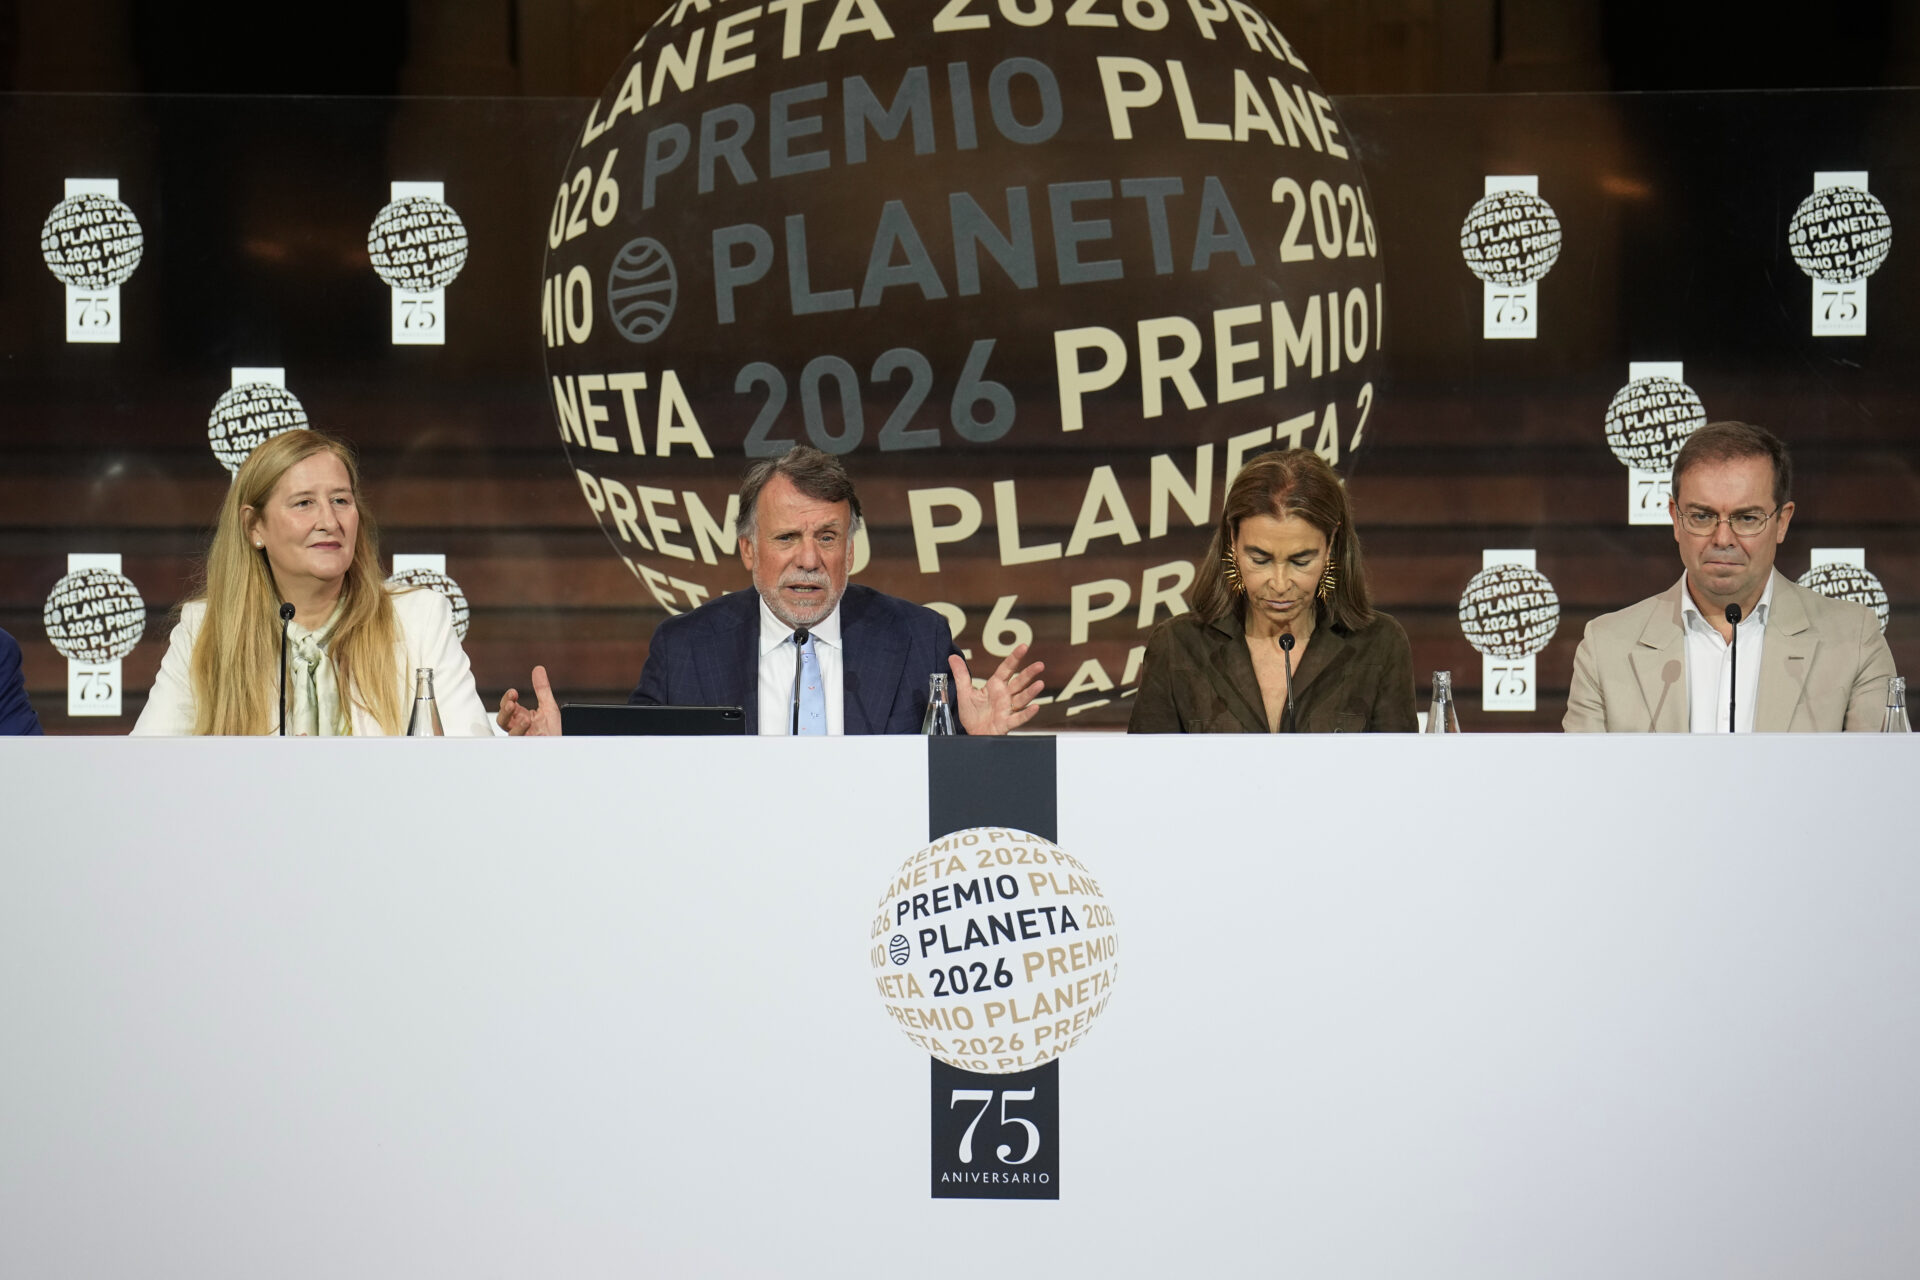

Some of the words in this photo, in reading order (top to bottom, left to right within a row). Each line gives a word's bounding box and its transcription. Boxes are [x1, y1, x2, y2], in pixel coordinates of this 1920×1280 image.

[642, 57, 1064, 210] PREMIO
[1096, 56, 1348, 160] PLANE
[52, 211, 104, 234] PREMIO
[378, 213, 429, 236] PREMIO
[1471, 207, 1522, 230] PREMIO
[1800, 203, 1852, 227] PREMIO
[61, 223, 127, 247] PLANETA
[387, 226, 452, 249] PLANETA
[1480, 220, 1546, 244] PLANETA
[1808, 215, 1876, 241] PLANETA
[65, 244, 101, 263] 2026
[391, 247, 427, 265] 2026
[712, 176, 1256, 325] PLANETA
[1484, 241, 1519, 260] 2026
[1812, 237, 1849, 256] 2026
[76, 298, 111, 327] 75
[401, 301, 436, 328] 75
[1493, 294, 1528, 324] 75
[1821, 291, 1857, 321] 75
[734, 338, 1016, 458] 2026
[1054, 287, 1368, 432] PREMIO
[219, 399, 270, 422] PREMIO
[1615, 393, 1667, 417] PREMIO
[228, 411, 293, 435] PLANETA
[1625, 406, 1691, 430] PLANETA
[1628, 427, 1664, 445] 2026
[55, 586, 106, 608] PREMIO
[1469, 581, 1521, 604] PREMIO
[64, 597, 129, 622] PLANETA
[1478, 593, 1544, 618] PLANETA
[67, 618, 103, 637] 2026
[1482, 614, 1518, 632] 2026
[77, 672, 112, 700] 75
[1492, 667, 1527, 696] 75
[975, 847, 1048, 869] 2026
[896, 874, 1019, 926] PREMIO
[1027, 872, 1104, 898] PLANE
[918, 905, 1080, 958] PLANETA
[876, 972, 925, 998] NETA
[929, 957, 1014, 997] 2026
[1022, 935, 1115, 983] PREMIO
[885, 1004, 974, 1031] PREMIO
[983, 969, 1110, 1028] PLANETA
[952, 1033, 1025, 1056] 2026
[950, 1086, 1041, 1165] 75
[941, 1172, 1050, 1184] ANIVERSARIO
